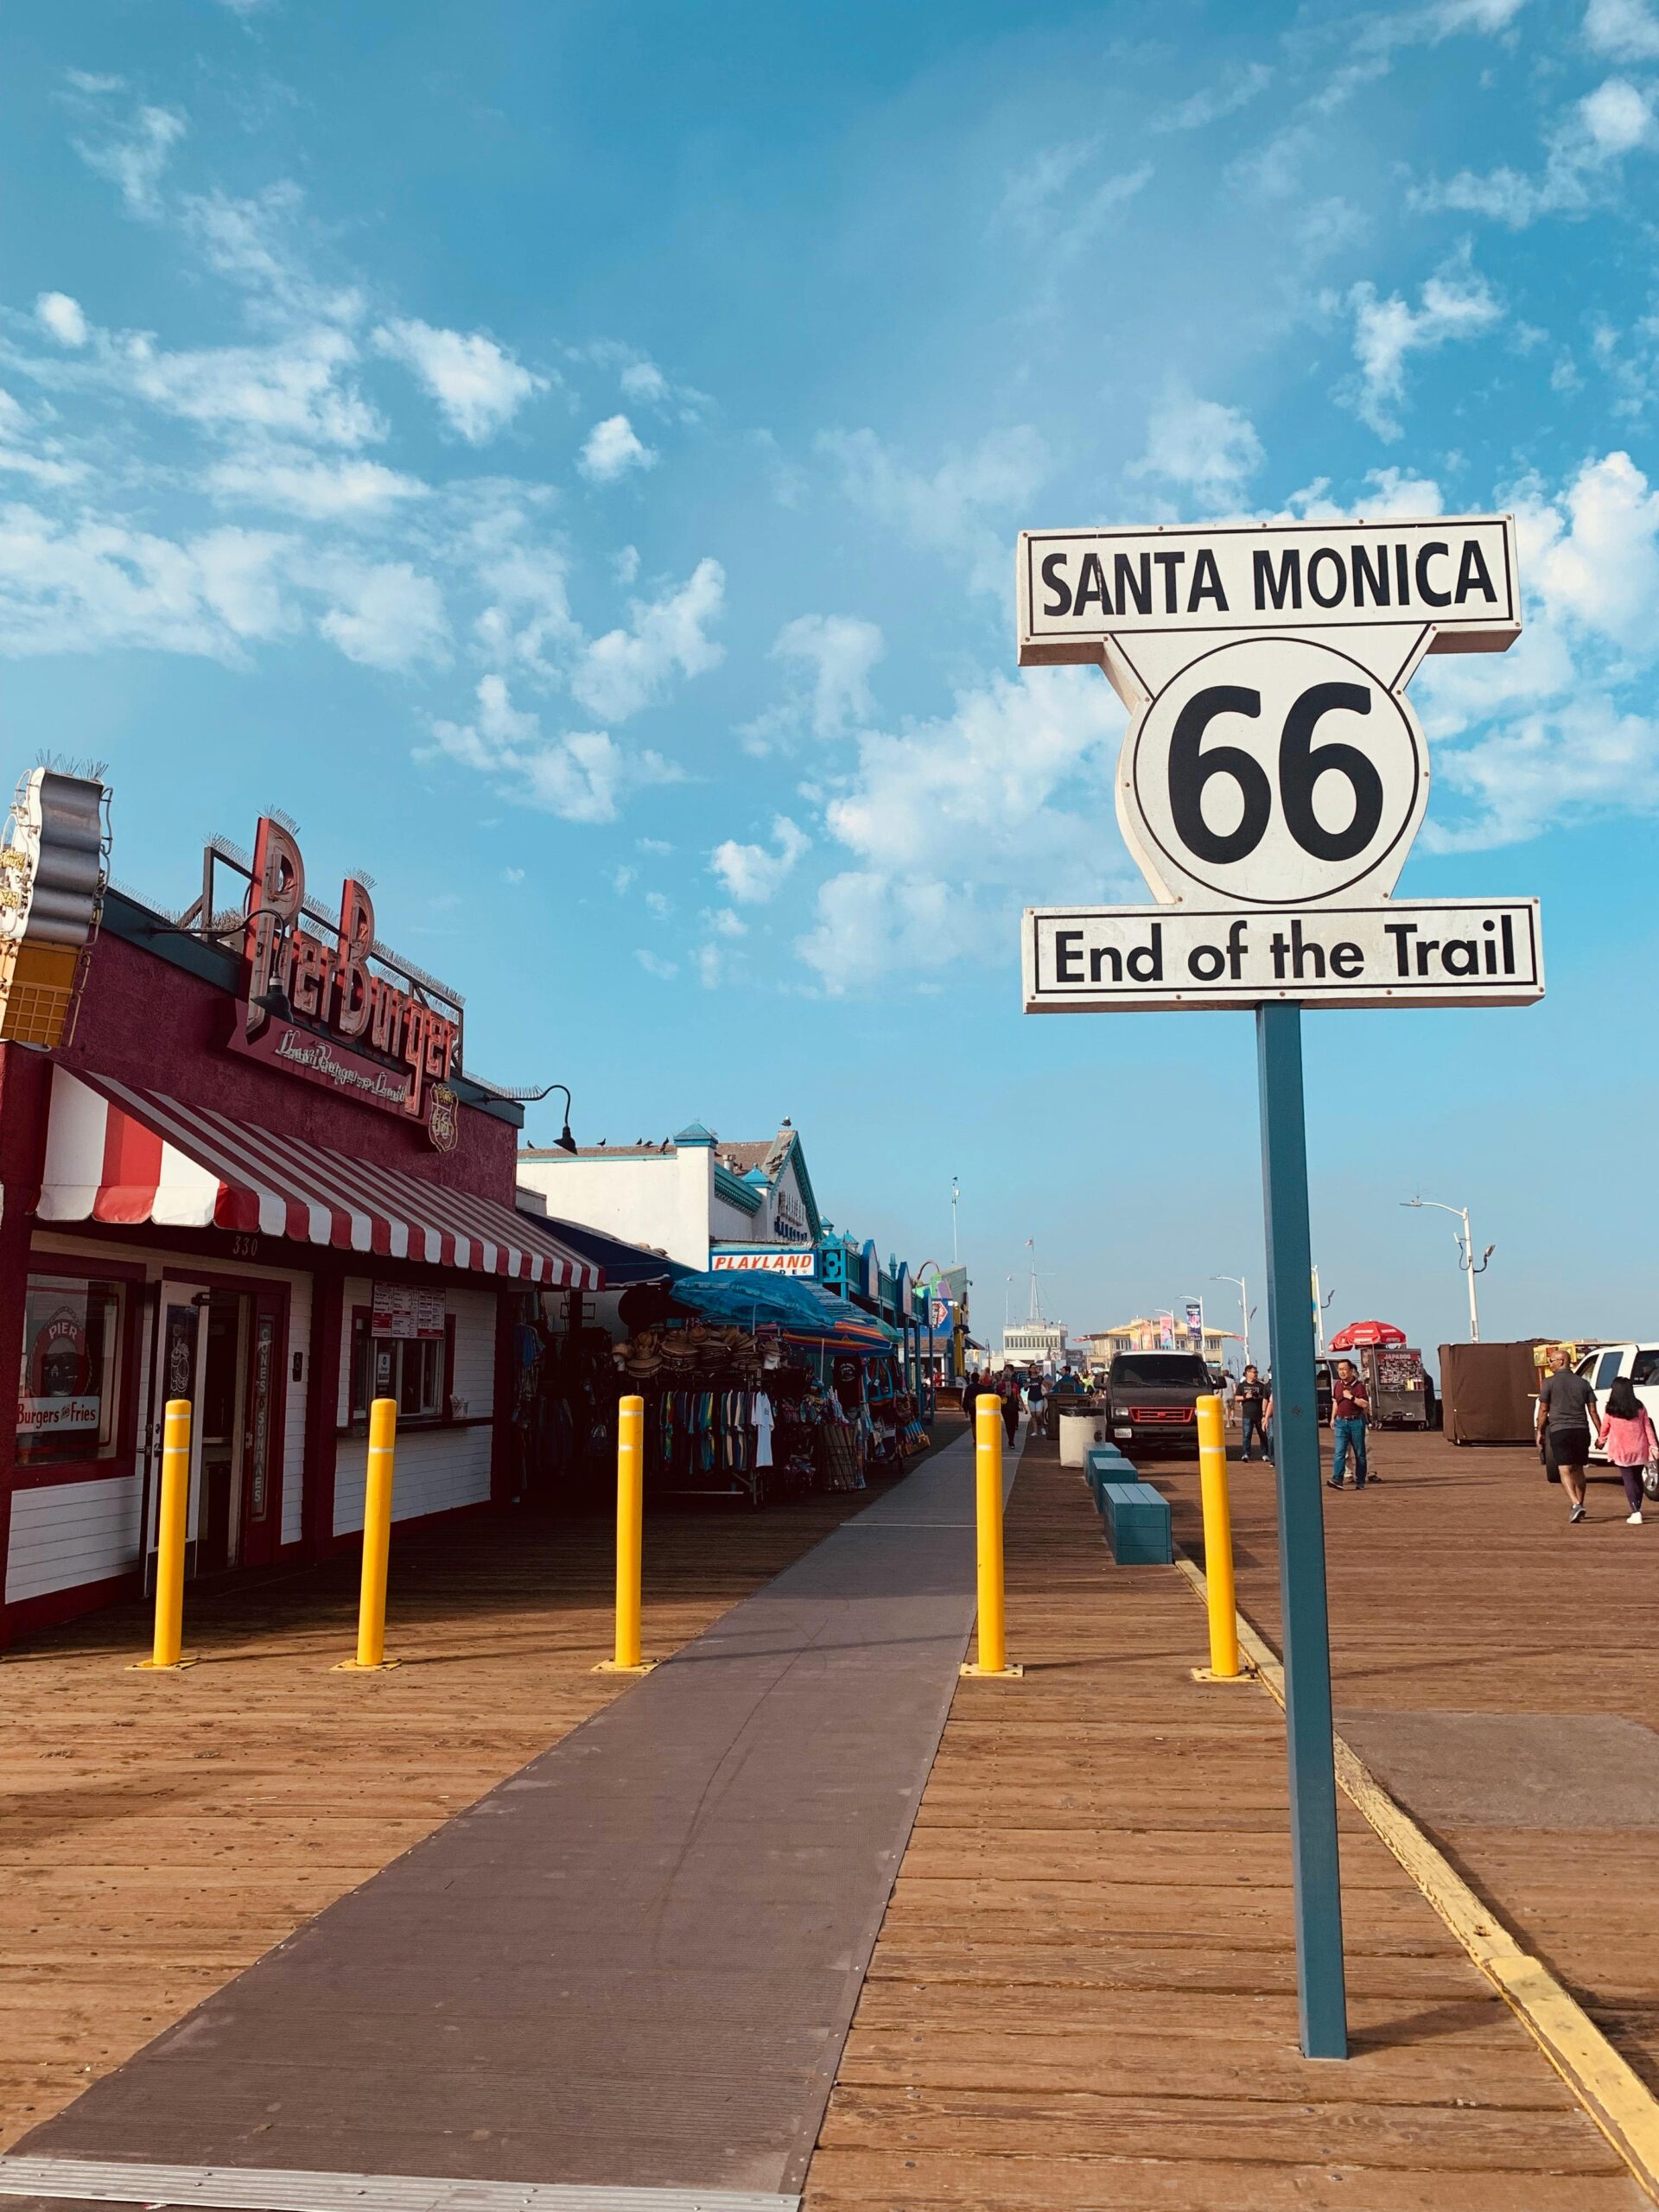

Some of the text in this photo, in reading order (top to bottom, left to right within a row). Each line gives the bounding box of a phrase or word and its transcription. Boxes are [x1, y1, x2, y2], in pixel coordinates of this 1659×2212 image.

[1041, 539, 1497, 617] SANTA MONICA
[1167, 681, 1383, 865] 66
[1055, 913, 1516, 983] End of the Trail
[232, 1235, 258, 1256] 330
[715, 1255, 812, 1269] PLAYLAND
[48, 1321, 78, 1340] PIER
[259, 1328, 270, 1393] CONES
[17, 1403, 60, 1429] Burgers
[71, 1402, 97, 1422] Fries
